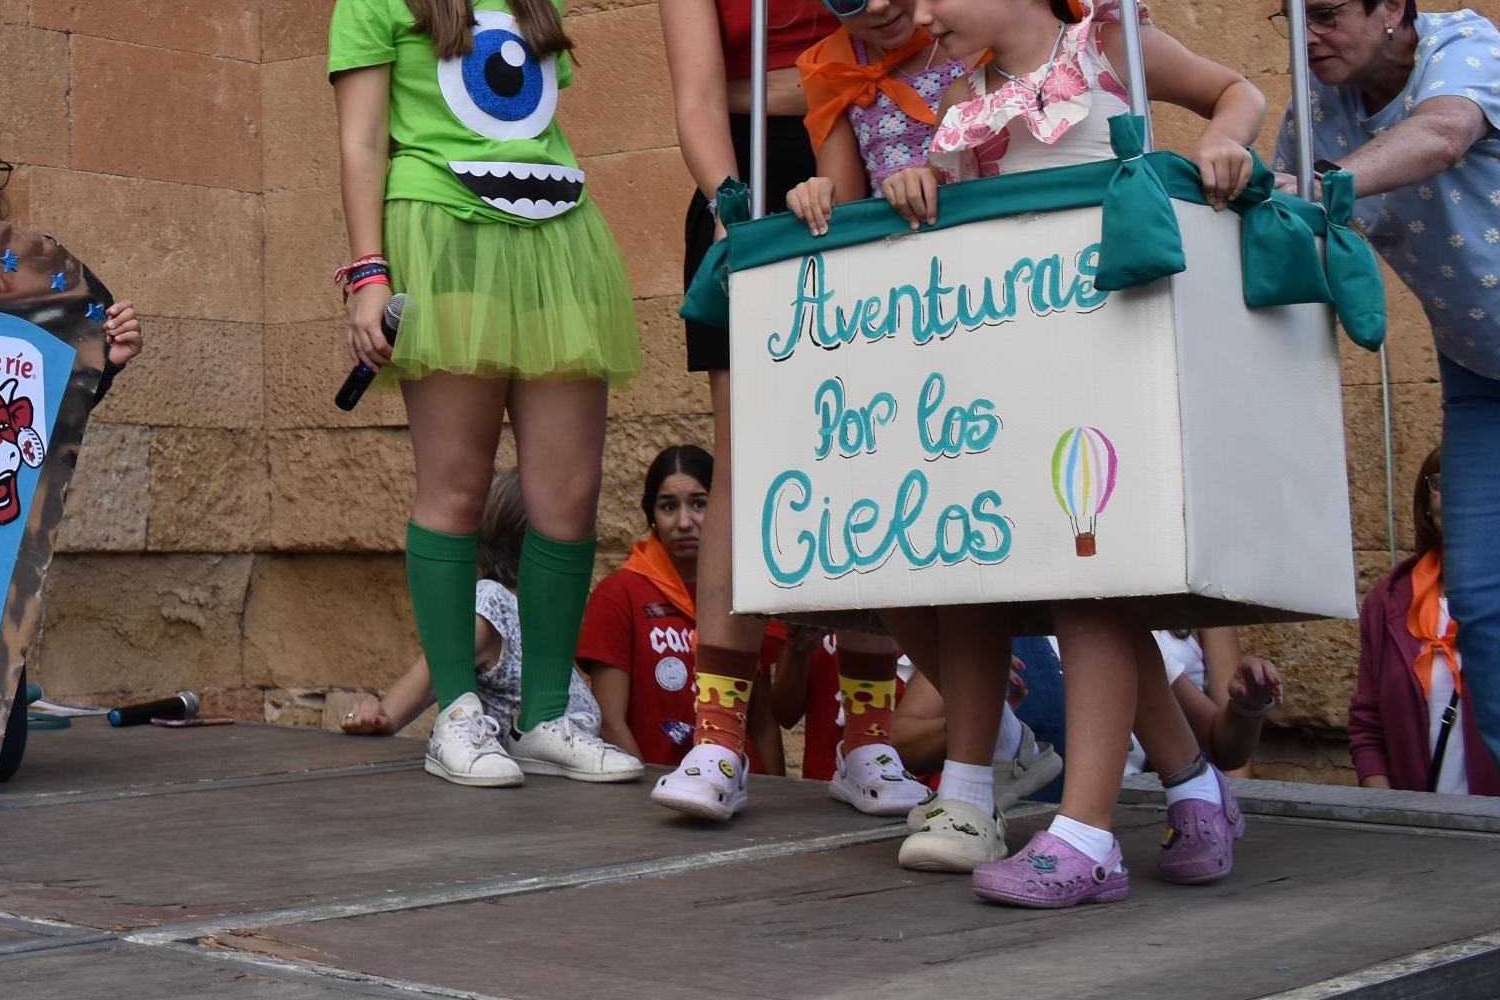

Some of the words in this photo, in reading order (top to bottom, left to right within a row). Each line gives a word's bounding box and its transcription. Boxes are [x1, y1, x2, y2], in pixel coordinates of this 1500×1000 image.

[767, 242, 1110, 359] Aventuras
[6, 352, 34, 380] ríe
[814, 377, 897, 458] Por
[917, 372, 1001, 457] los
[762, 469, 1013, 586] Cielos
